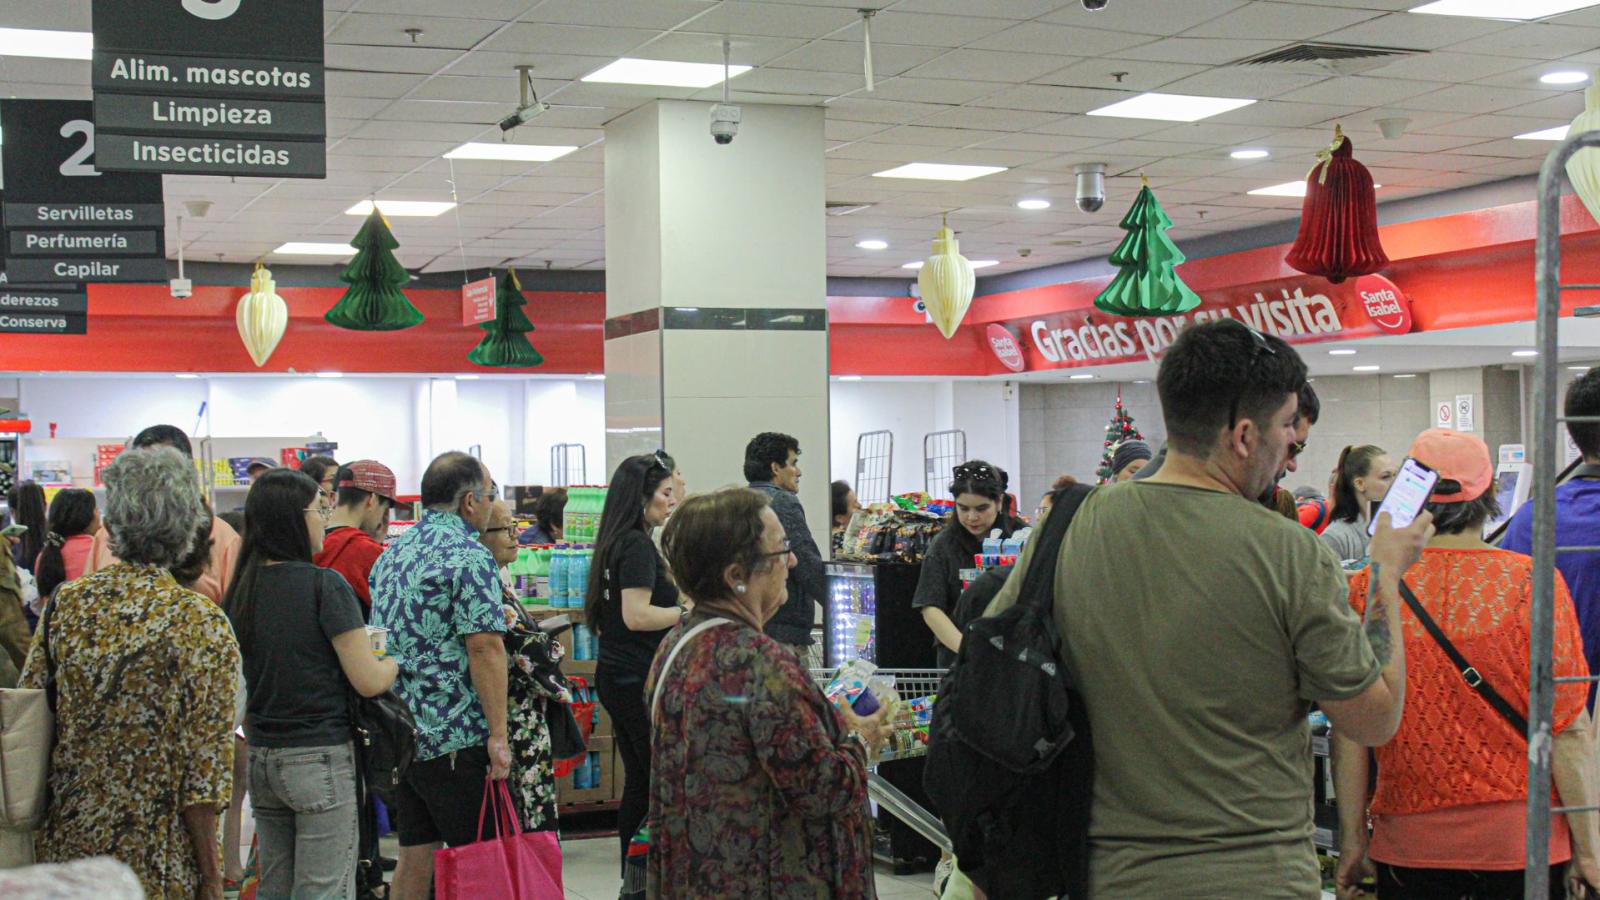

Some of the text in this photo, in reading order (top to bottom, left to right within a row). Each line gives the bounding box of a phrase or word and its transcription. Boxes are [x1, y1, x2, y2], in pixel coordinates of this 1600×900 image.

[110, 57, 312, 89] Alim. mascotas
[152, 101, 272, 127] Limpieza
[59, 119, 104, 176] 2
[132, 140, 290, 166] Insecticidas
[37, 206, 134, 221] Servilletas
[26, 233, 128, 249] Perfumería
[54, 261, 120, 279] Capilar
[0, 293, 59, 307] derezos
[1360, 288, 1396, 305] Santa
[0, 315, 67, 328] Conserva
[1031, 320, 1137, 362] Gracias
[1236, 287, 1343, 336] visita
